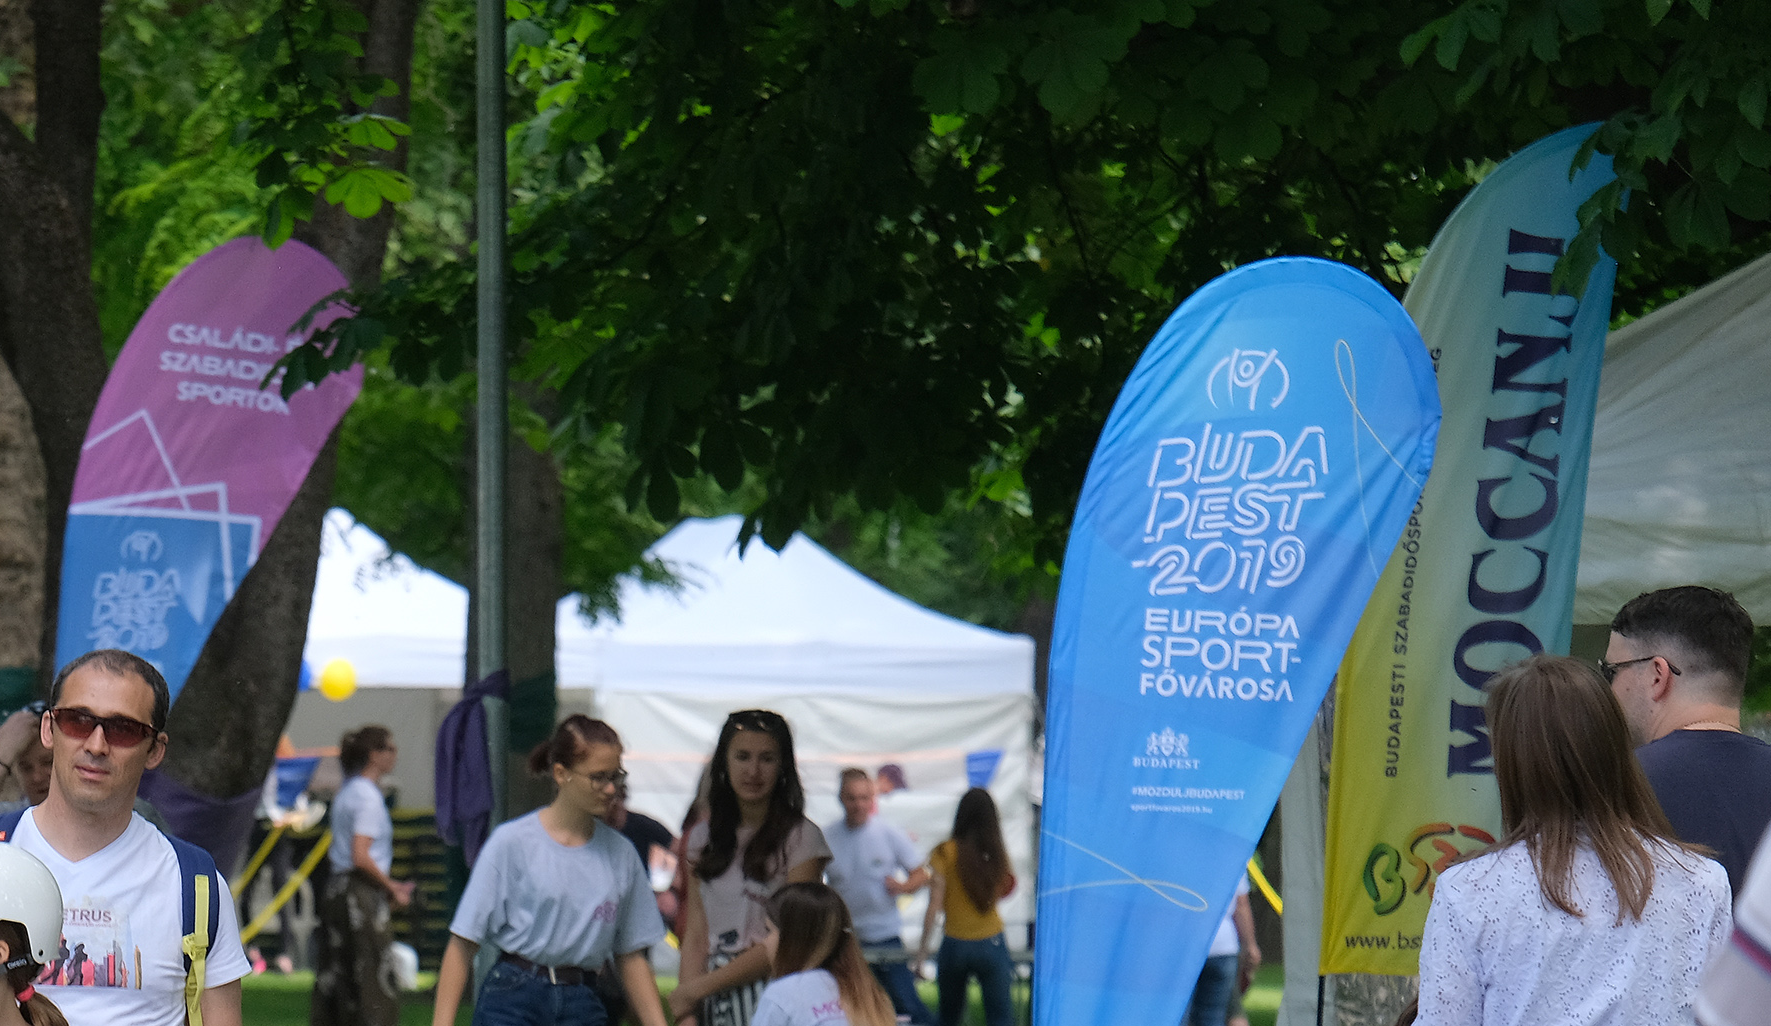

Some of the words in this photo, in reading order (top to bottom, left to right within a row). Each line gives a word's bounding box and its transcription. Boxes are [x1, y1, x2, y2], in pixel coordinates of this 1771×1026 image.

[1147, 422, 1328, 488] BUDA
[1143, 482, 1326, 543] PEST
[92, 567, 181, 600] BUDA
[1131, 535, 1306, 596] 2019
[1393, 489, 1425, 656] SZABADIDŐSPO
[1144, 605, 1301, 640] EURÓPA
[1141, 634, 1302, 674] SPORT-
[1140, 668, 1294, 702] FŐVÁROSA
[1385, 663, 1406, 779] BUDAPESTI
[1132, 756, 1200, 770] BUDAPEST
[1345, 931, 1422, 950] www.bs
